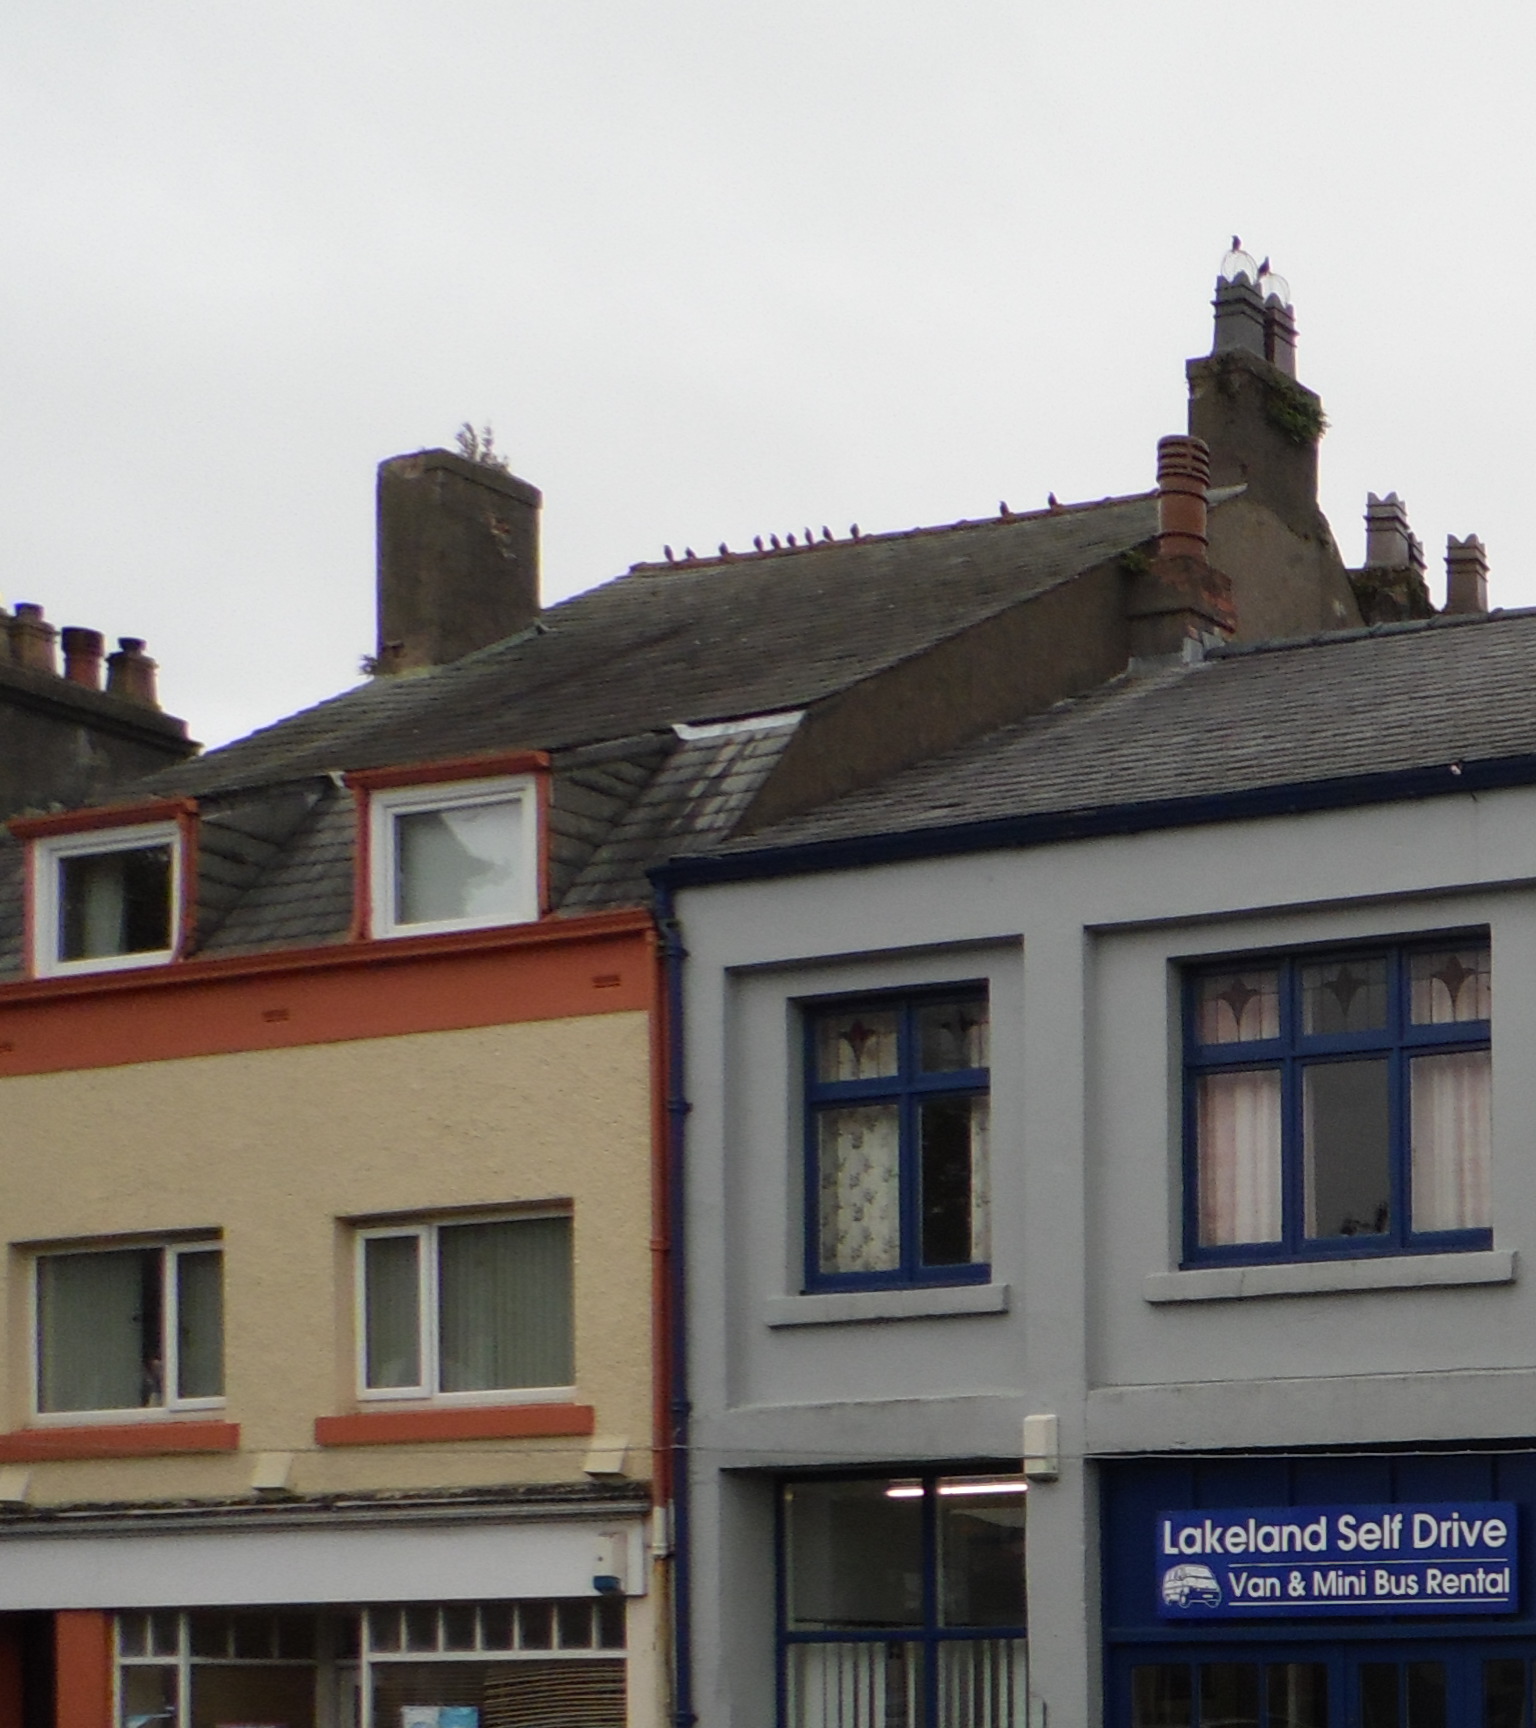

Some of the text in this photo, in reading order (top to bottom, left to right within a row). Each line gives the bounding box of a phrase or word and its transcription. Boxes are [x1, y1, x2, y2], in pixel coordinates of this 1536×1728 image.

[1163, 1512, 1508, 1555] Lakeland Self Drive
[1228, 1567, 1511, 1598] Van & Mini Bus Rental
